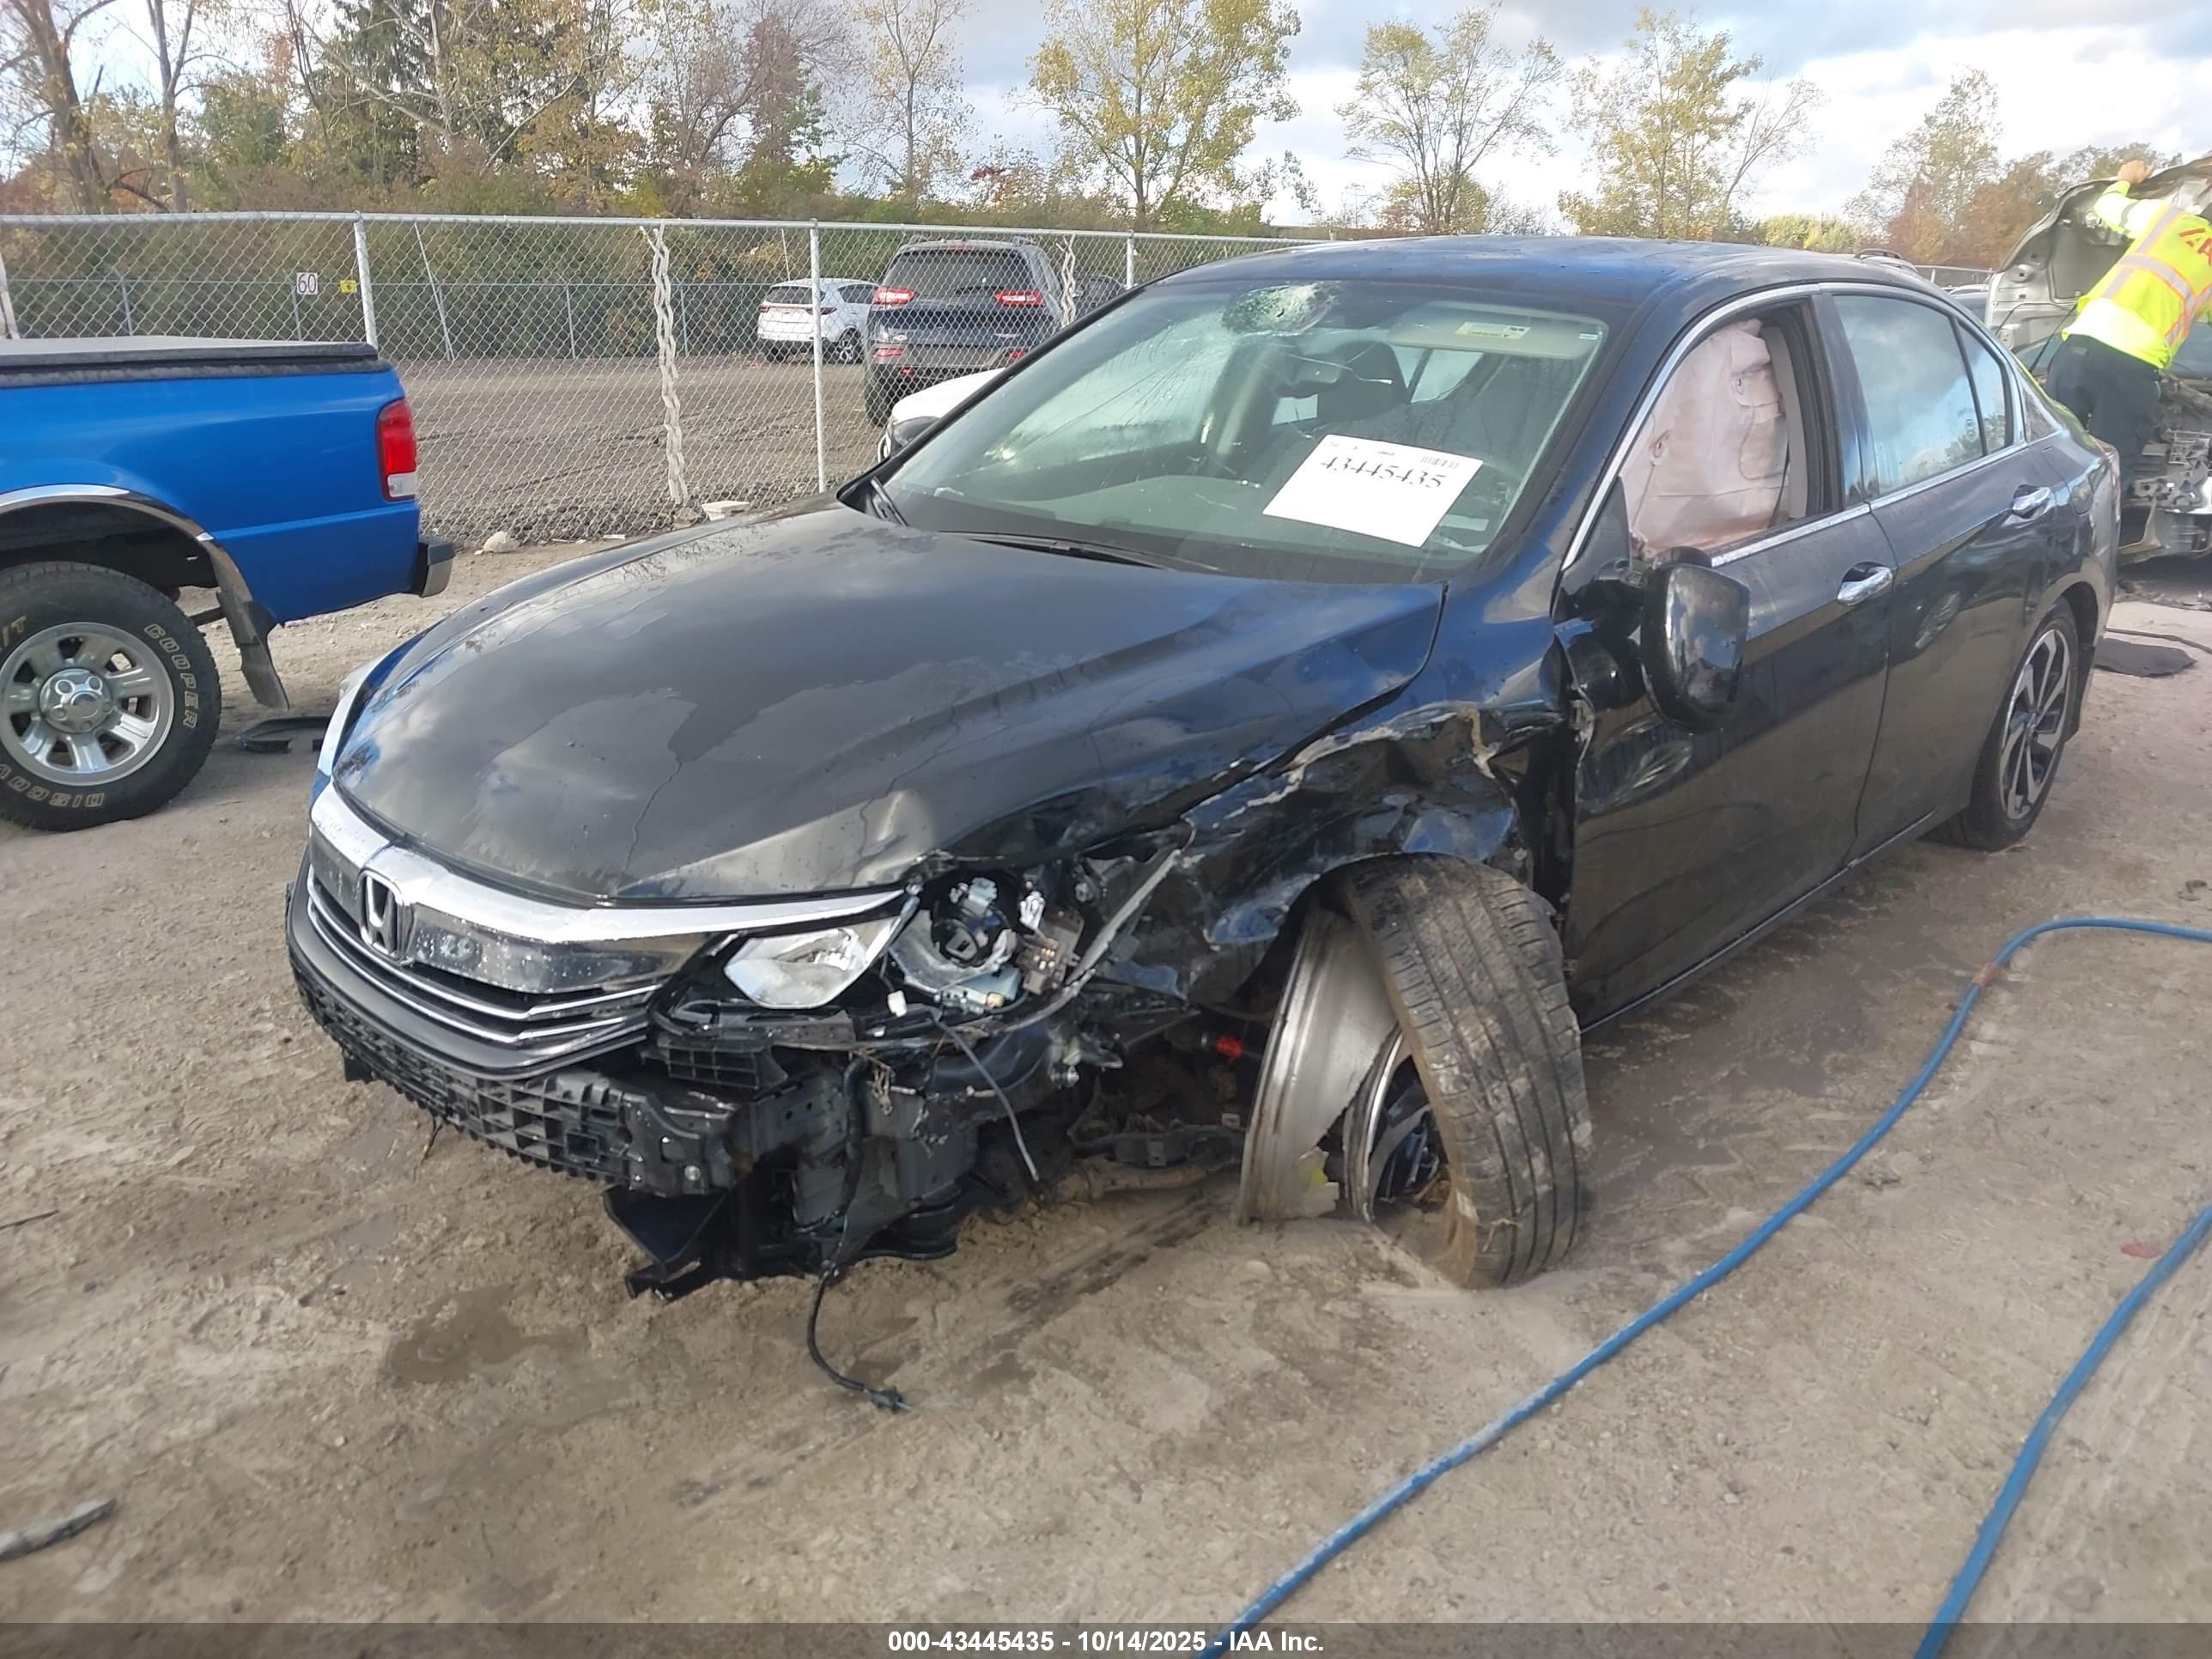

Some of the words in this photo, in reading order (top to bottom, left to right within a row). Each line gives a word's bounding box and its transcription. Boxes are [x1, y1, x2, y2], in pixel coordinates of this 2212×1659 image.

[298, 273, 317, 294] 60
[1320, 456, 1447, 489] 43445435
[143, 623, 199, 729] COOPER
